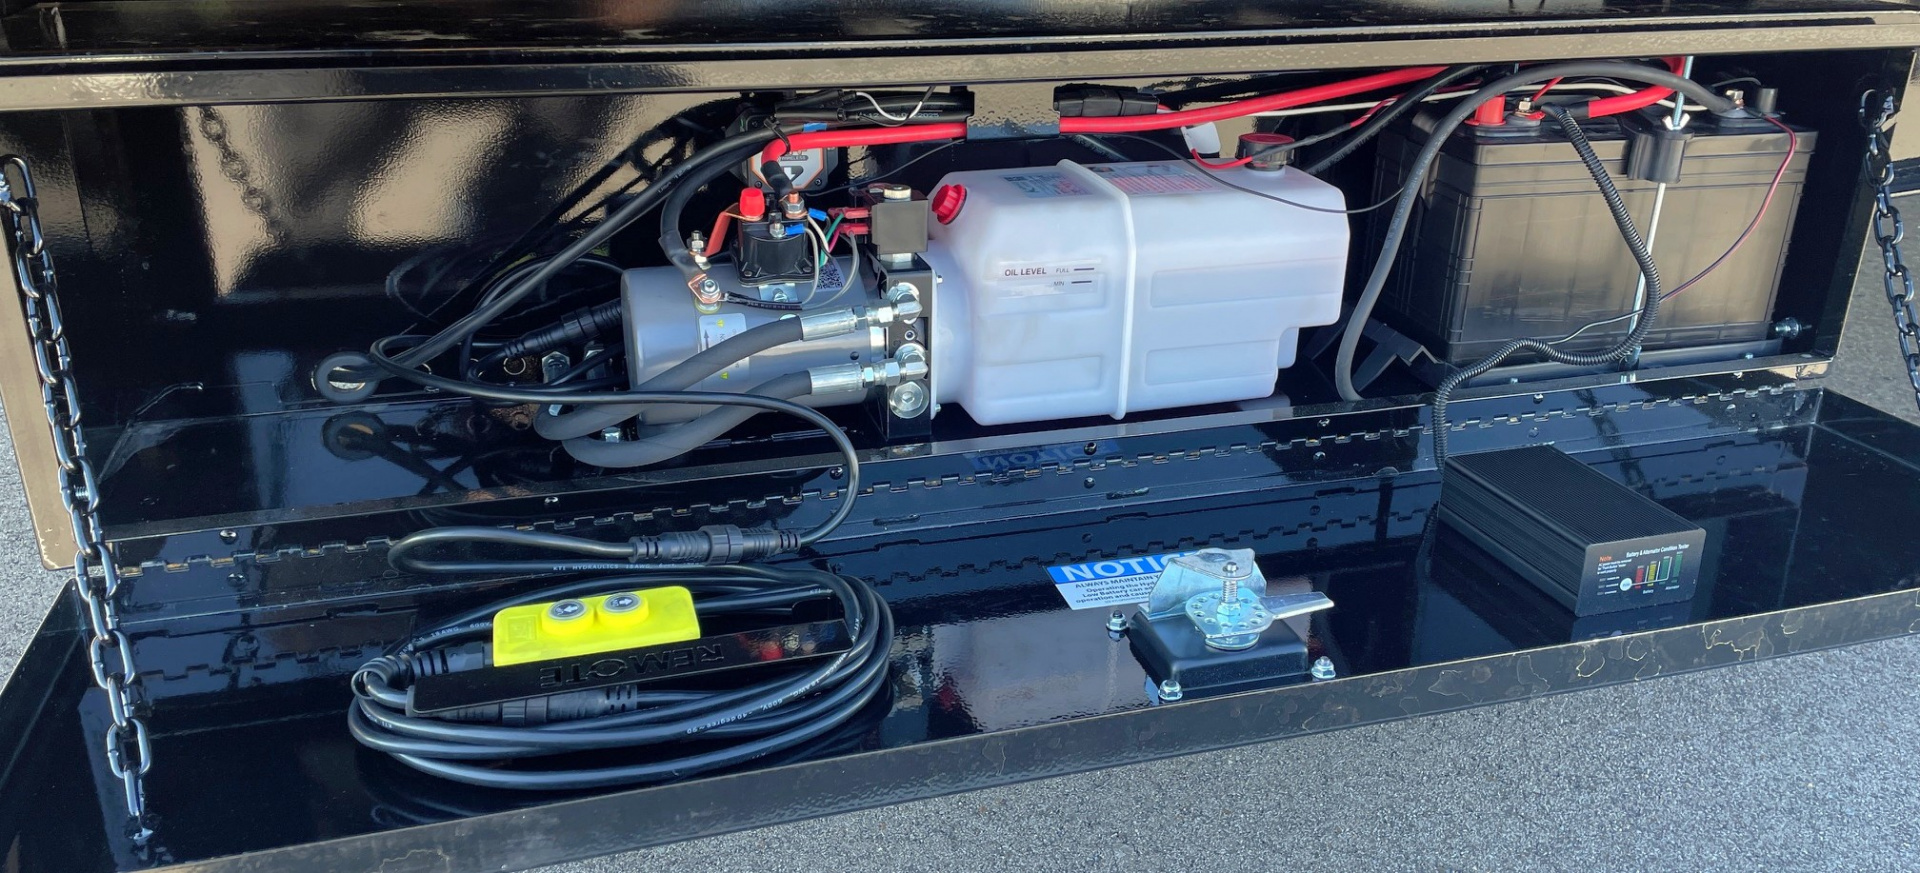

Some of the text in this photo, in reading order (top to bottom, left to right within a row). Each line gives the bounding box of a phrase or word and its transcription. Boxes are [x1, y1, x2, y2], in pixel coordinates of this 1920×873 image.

[1004, 268, 1018, 276] OIL
[1020, 267, 1047, 276] LEVEL
[1061, 551, 1198, 581] NOTIC
[1075, 580, 1110, 589] ALWAYS
[1111, 574, 1154, 585] MAINTAIN
[1086, 582, 1126, 593] Operating
[1100, 588, 1128, 596] Battery
[1076, 595, 1114, 604] operation
[539, 643, 725, 688] REMOTE
